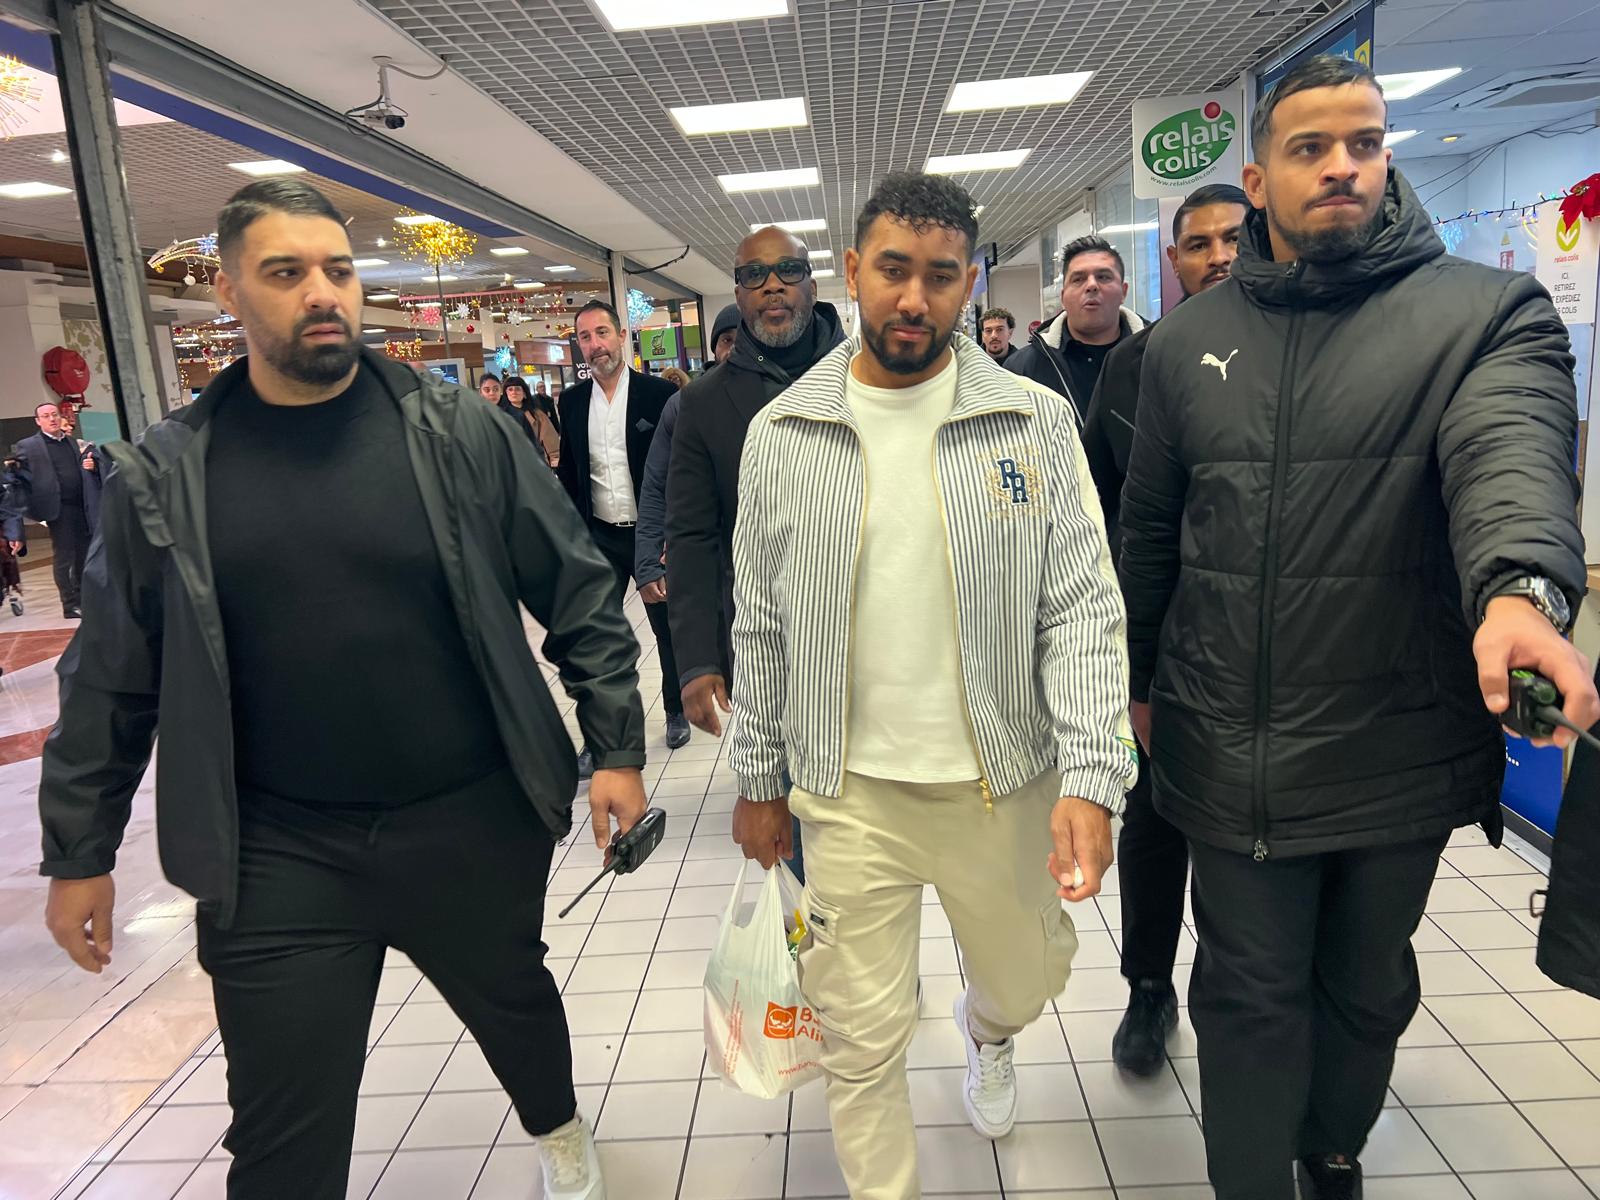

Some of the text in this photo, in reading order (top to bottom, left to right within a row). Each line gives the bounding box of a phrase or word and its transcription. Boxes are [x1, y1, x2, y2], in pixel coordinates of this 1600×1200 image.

[1150, 102, 1235, 154] relais
[1152, 147, 1212, 175] colis
[1150, 165, 1217, 187] www.relaiscolis.com
[1554, 283, 1576, 291] RETIREZ
[1562, 306, 1577, 314] COLIS
